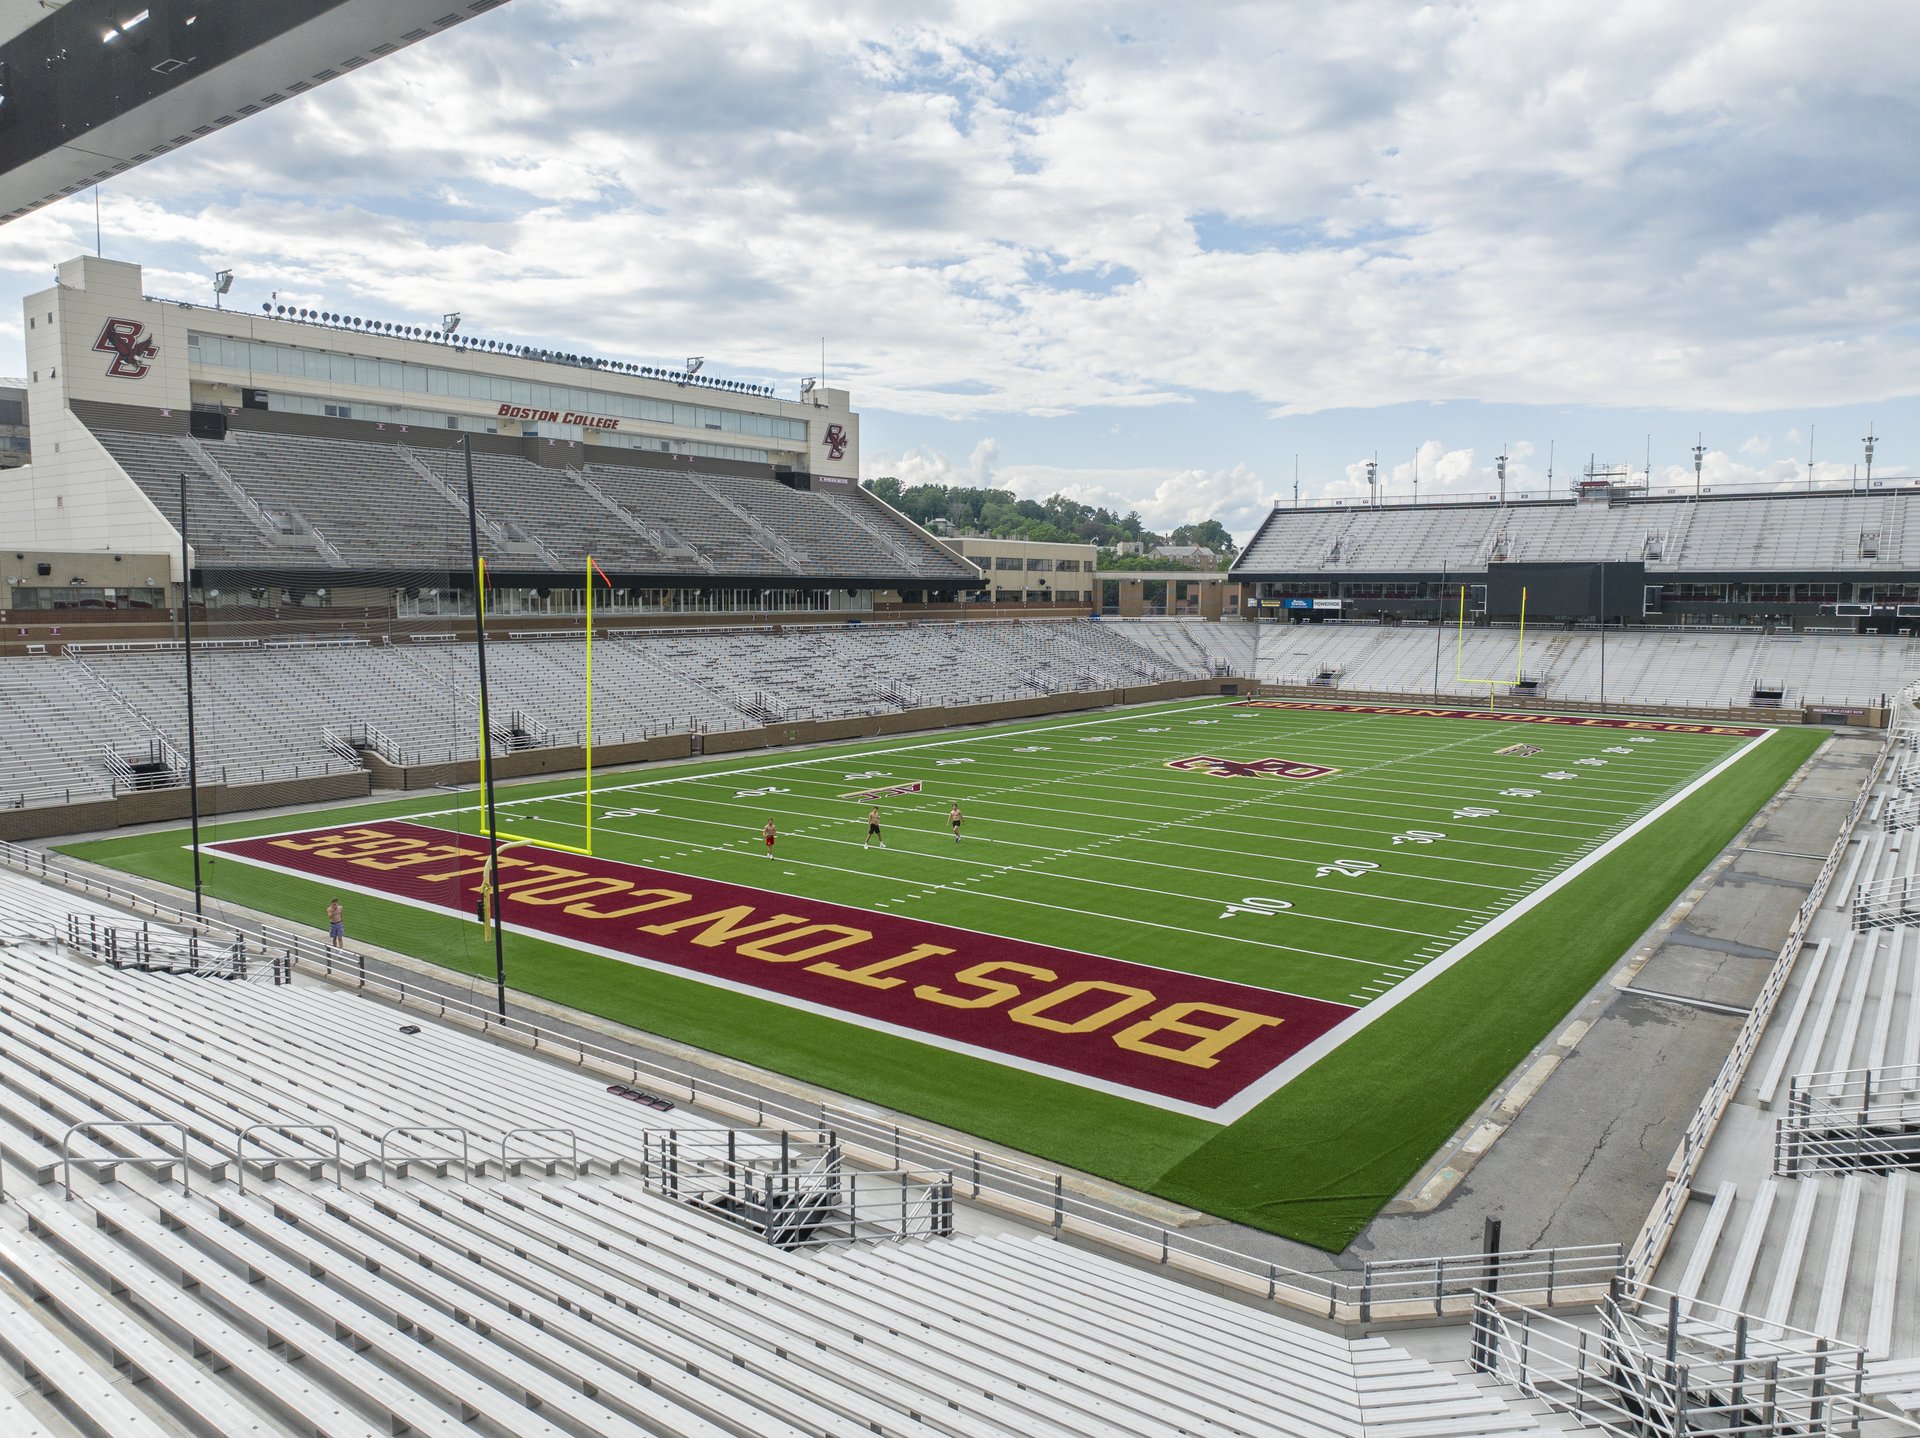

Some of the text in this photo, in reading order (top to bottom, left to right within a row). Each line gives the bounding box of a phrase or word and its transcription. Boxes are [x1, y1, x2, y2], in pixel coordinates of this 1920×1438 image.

[1392, 830, 1447, 845] 30
[1317, 859, 1381, 878] 20
[1226, 897, 1295, 917] 10
[635, 905, 1286, 1070] BOSTON
